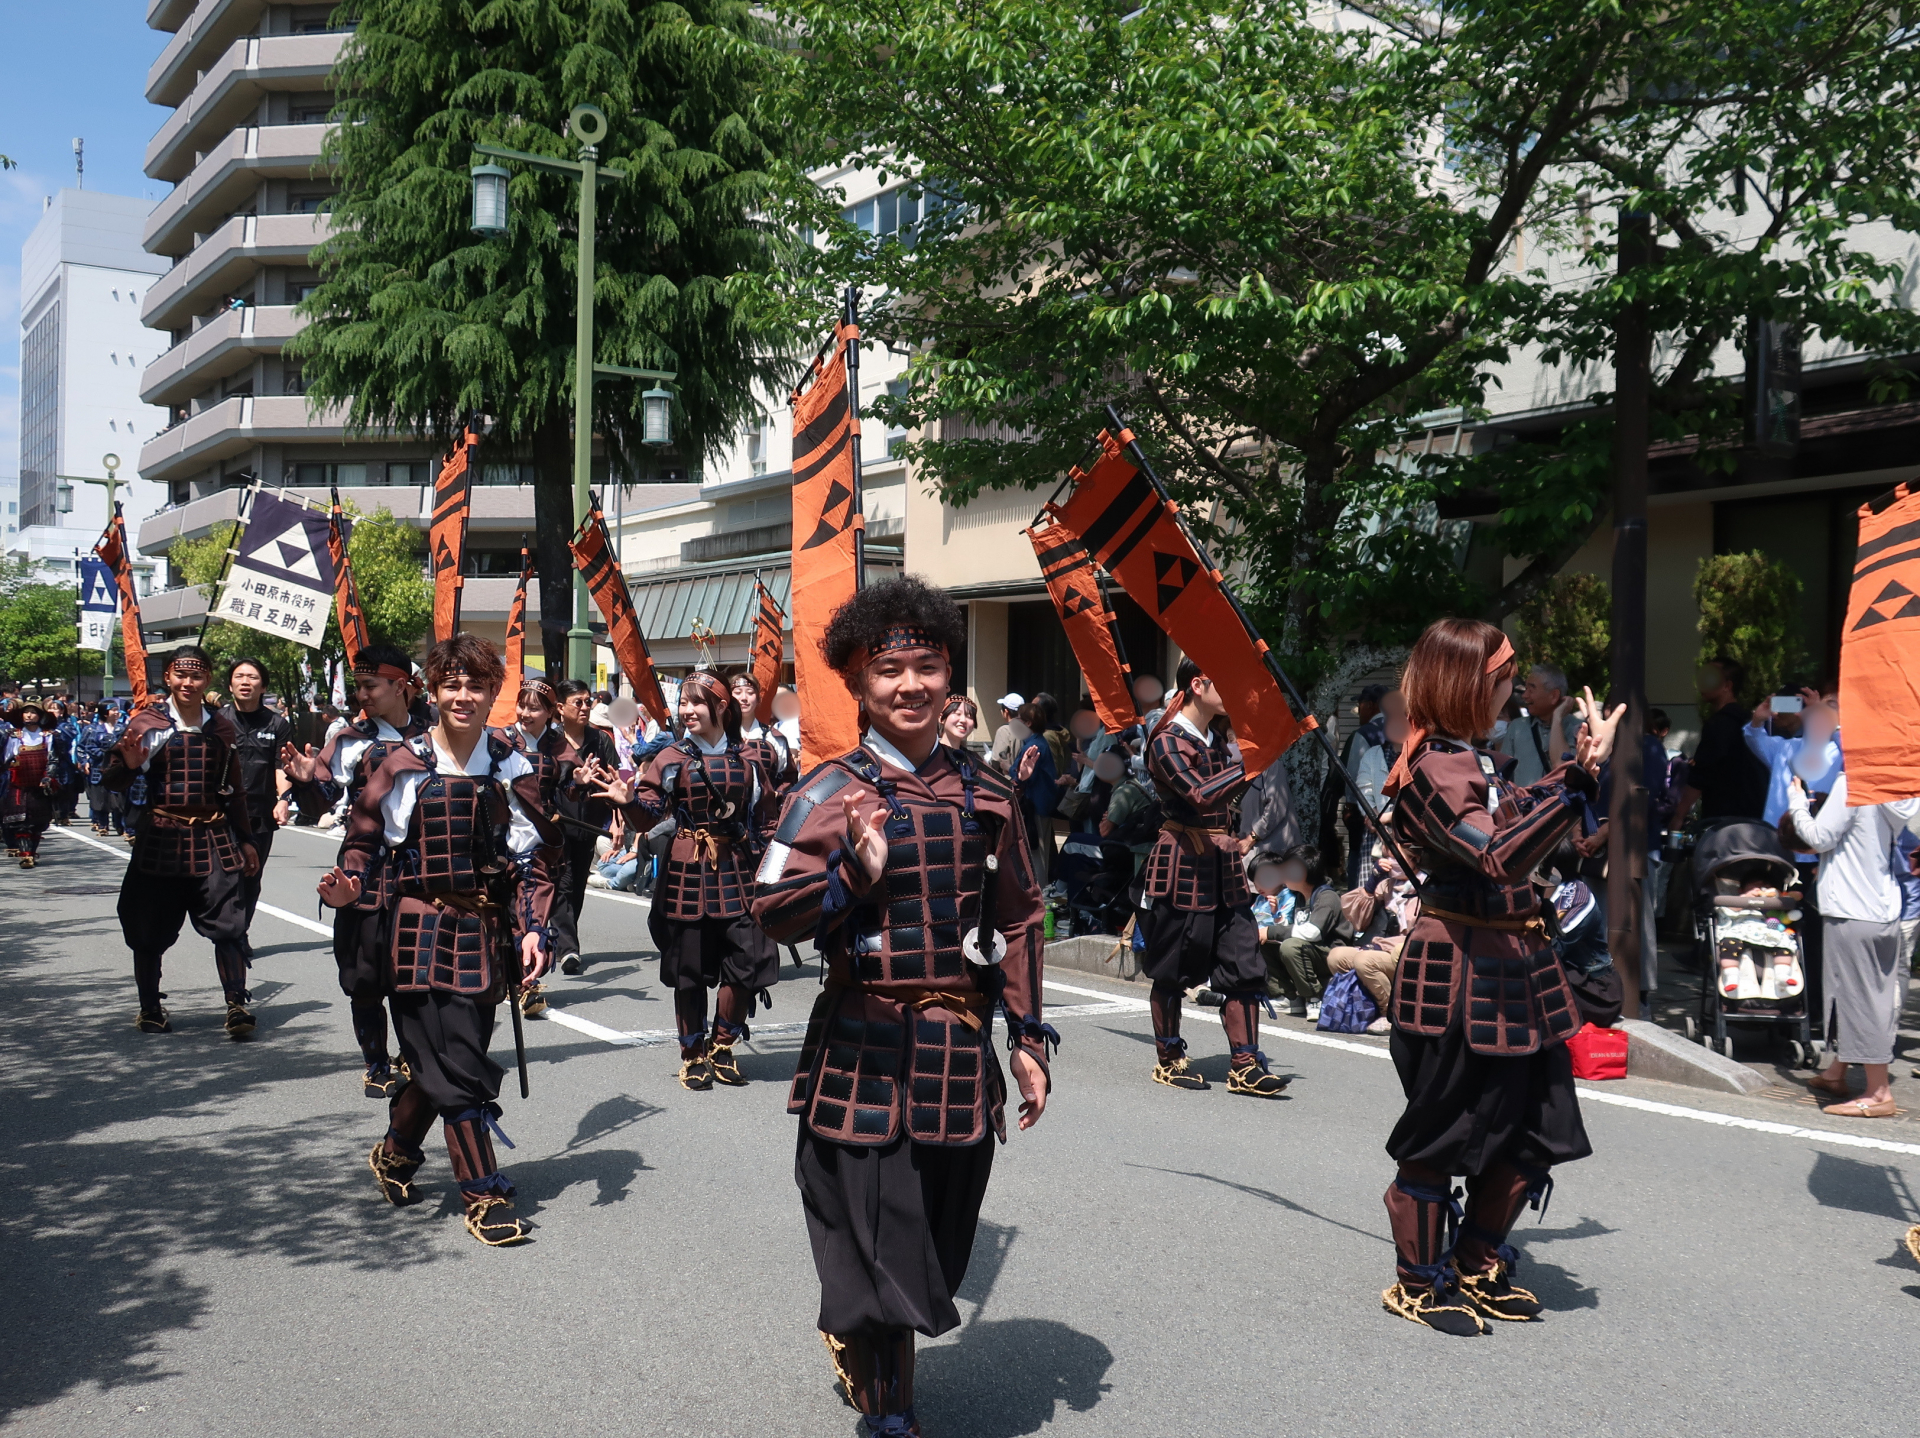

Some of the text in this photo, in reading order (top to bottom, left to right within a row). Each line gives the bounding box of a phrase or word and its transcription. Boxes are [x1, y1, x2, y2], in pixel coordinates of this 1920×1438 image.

[241, 578, 316, 612] 小田原市役所
[229, 597, 314, 636] 職員互助会
